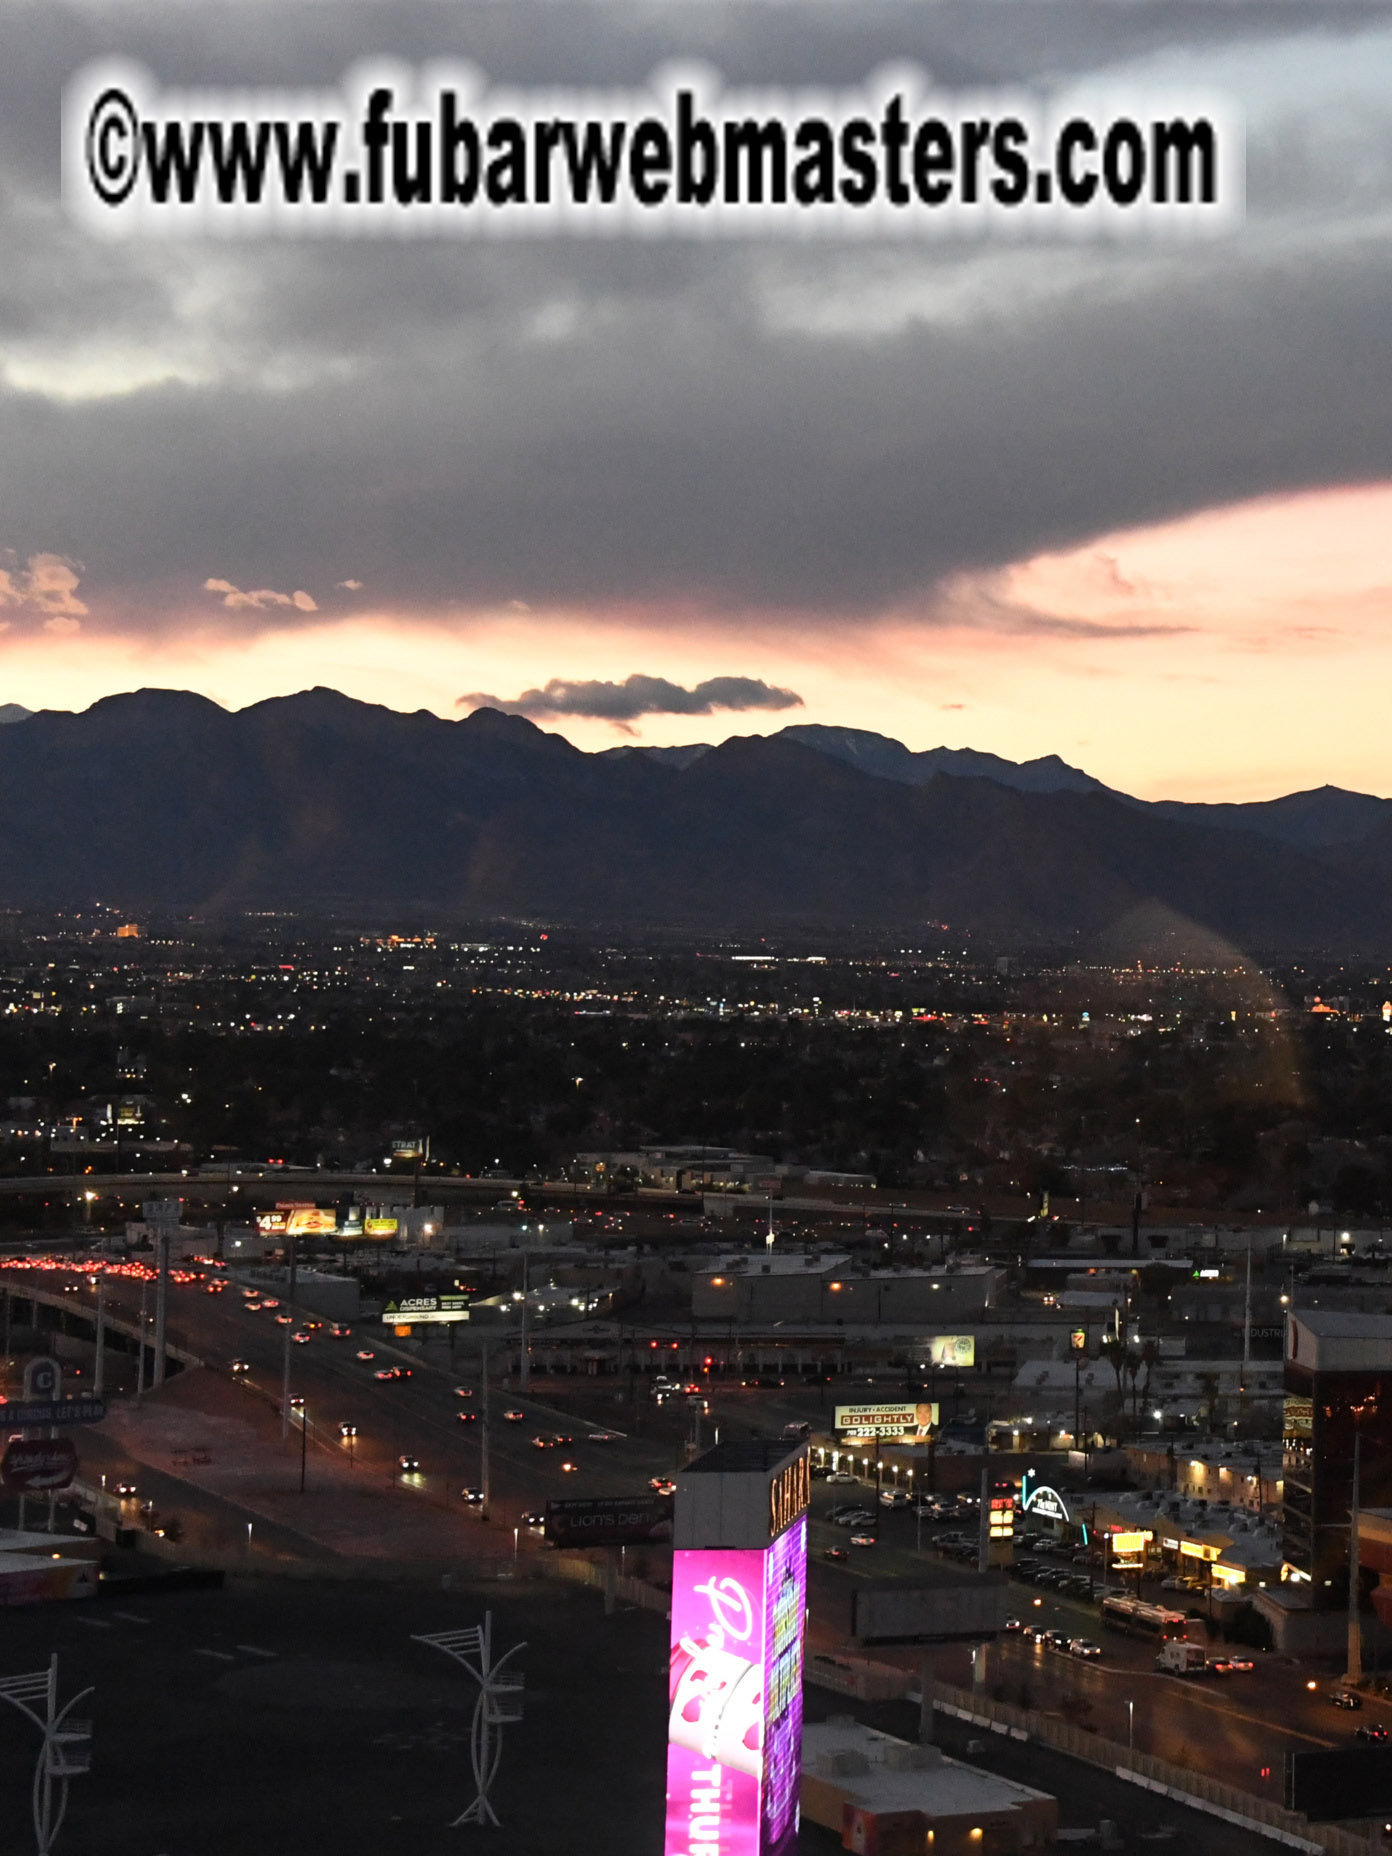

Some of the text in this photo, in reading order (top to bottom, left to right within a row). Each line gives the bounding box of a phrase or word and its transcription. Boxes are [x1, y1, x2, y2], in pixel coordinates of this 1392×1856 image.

[392, 1140, 416, 1148] STRAT
[400, 1298, 437, 1306] ACRES
[57, 1407, 81, 1418] LET'S
[842, 1415, 913, 1425] GOLIGHTLY
[857, 1426, 904, 1437] 222-3333
